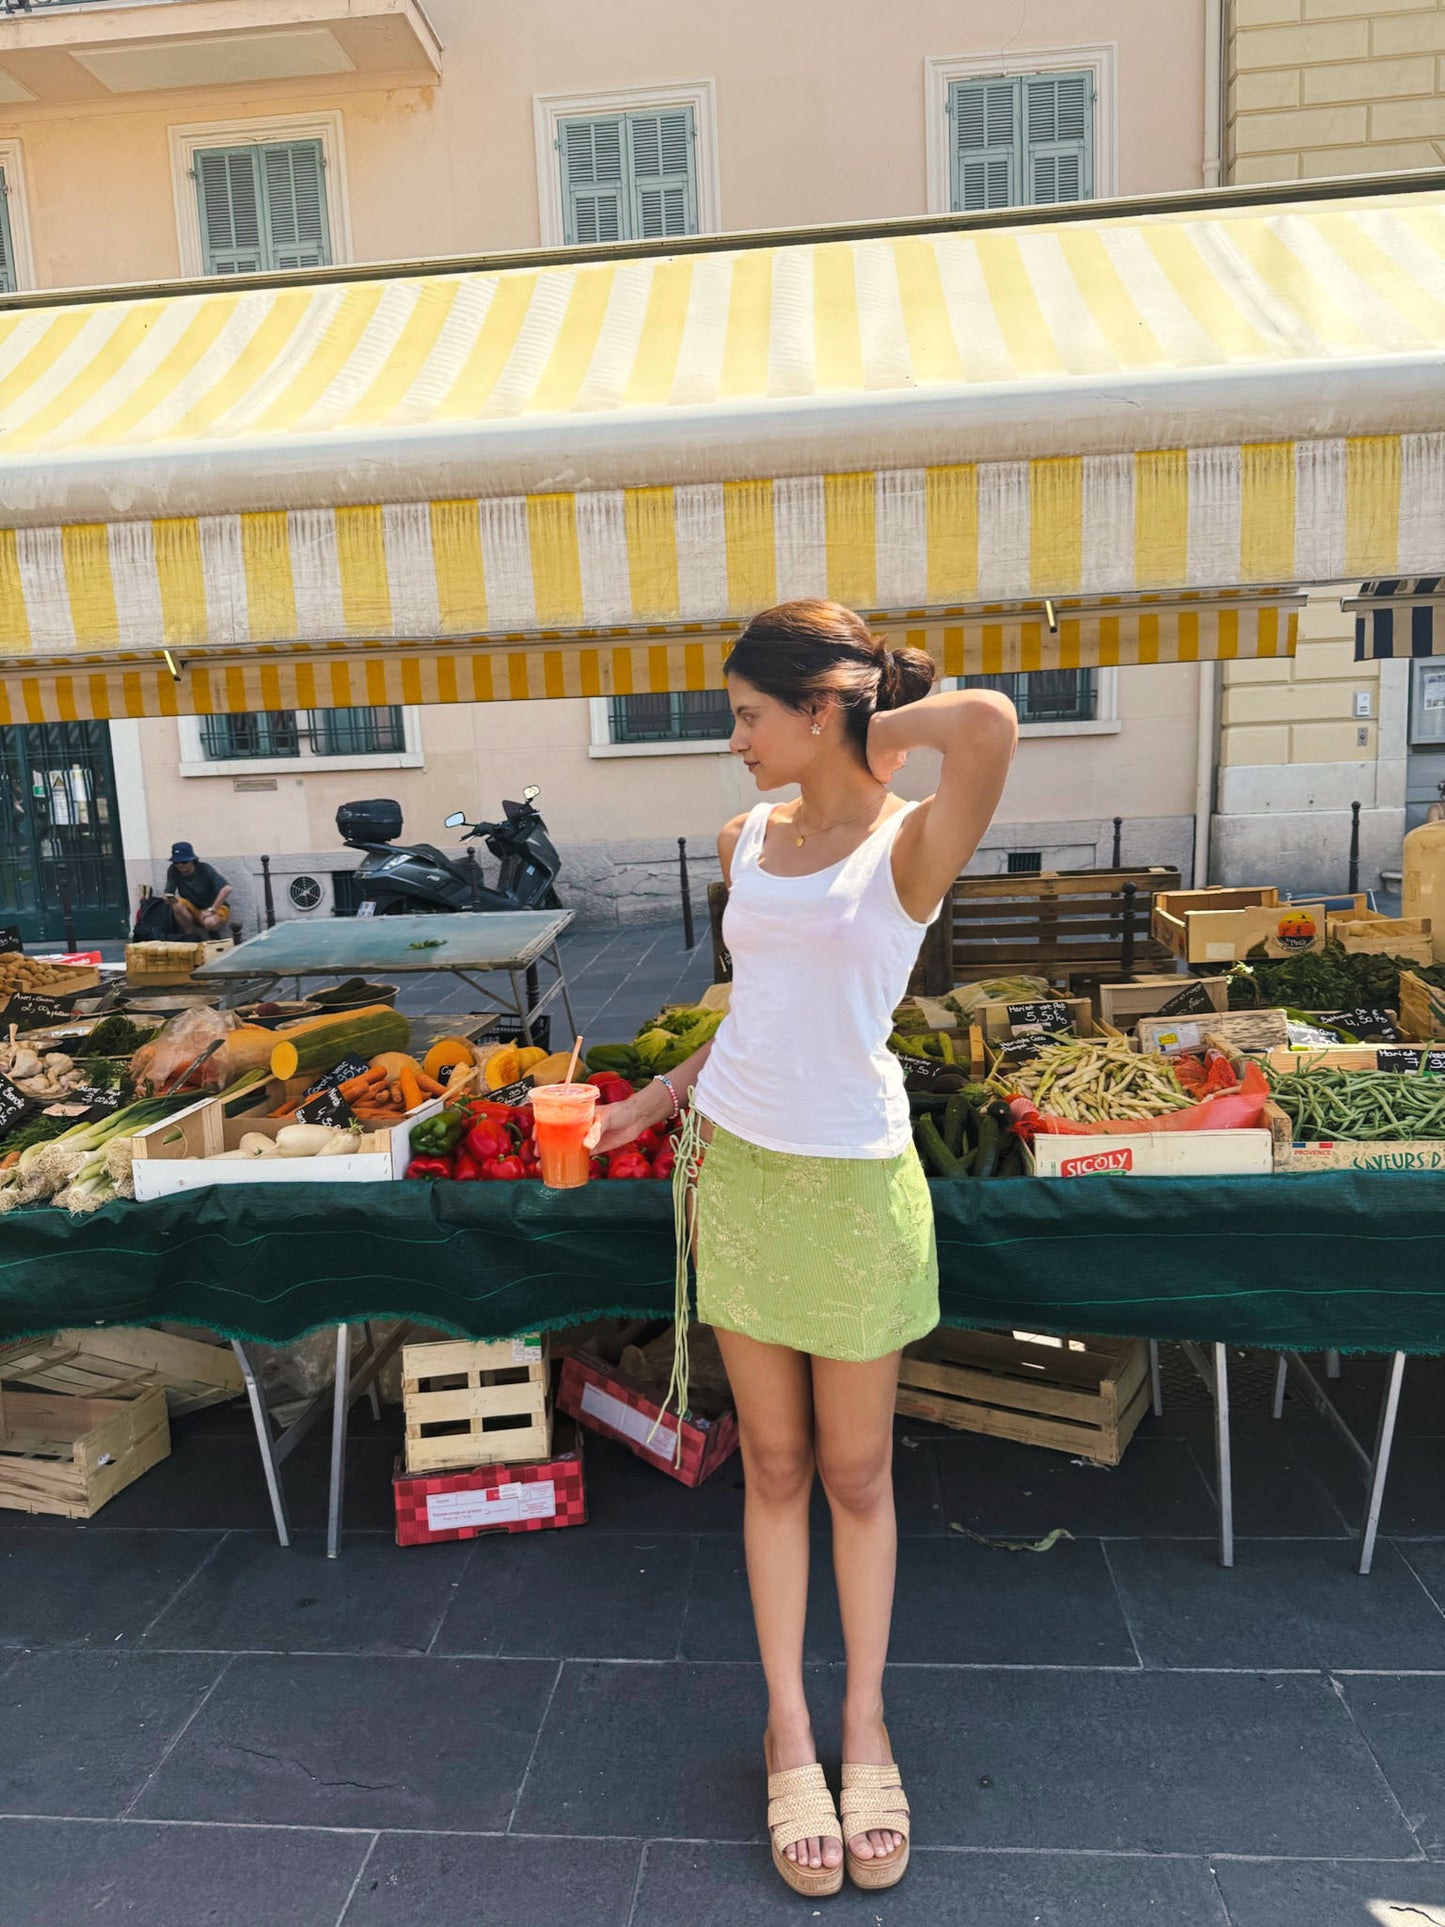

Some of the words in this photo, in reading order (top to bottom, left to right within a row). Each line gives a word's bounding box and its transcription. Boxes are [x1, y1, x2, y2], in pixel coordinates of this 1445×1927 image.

[1344, 1015, 1374, 1028] 4,50
[1294, 1149, 1332, 1157] PROVENCE
[1066, 1151, 1129, 1178] SICOLY
